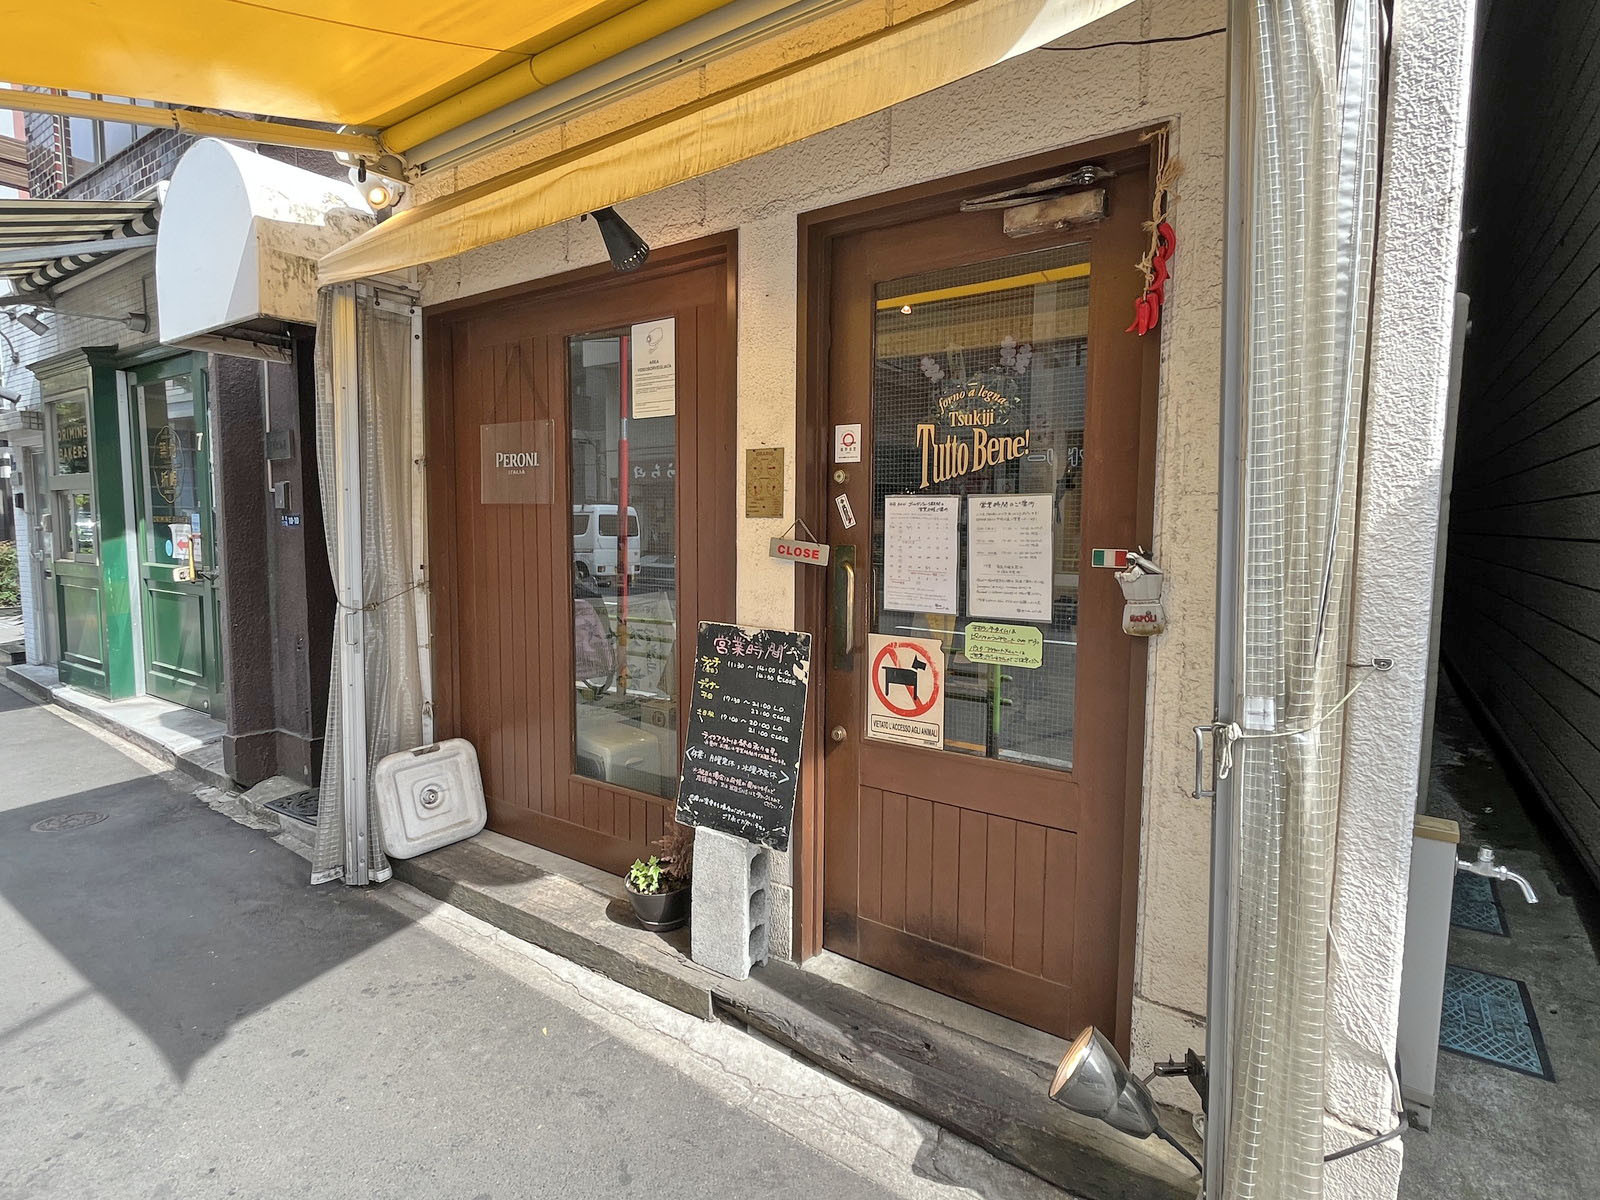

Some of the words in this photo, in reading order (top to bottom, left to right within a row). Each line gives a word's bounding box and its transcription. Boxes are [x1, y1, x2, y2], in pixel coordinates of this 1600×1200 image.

[938, 390, 966, 415] forno
[978, 384, 1008, 406] legna
[949, 408, 995, 428] Tsukiji
[59, 445, 88, 460] BAKERS
[916, 423, 970, 490] Tutto
[970, 427, 1030, 473] Bene!
[777, 544, 820, 560] CLOSE
[713, 634, 785, 664] 営業時間
[700, 655, 721, 667] ランチ
[727, 660, 744, 669] 11:30
[757, 664, 776, 674] 14:00
[697, 677, 720, 690] ディナー
[700, 690, 714, 699] 平日
[722, 695, 741, 704] 17:30
[752, 700, 771, 710] 21:00
[720, 713, 739, 723] 17:00
[749, 720, 771, 730] 20:00
[750, 708, 770, 718] 22:00
[772, 713, 791, 723] CLOSE
[873, 720, 888, 730] VIETATO
[748, 727, 769, 738] 21:00
[770, 731, 790, 743] CLOSE
